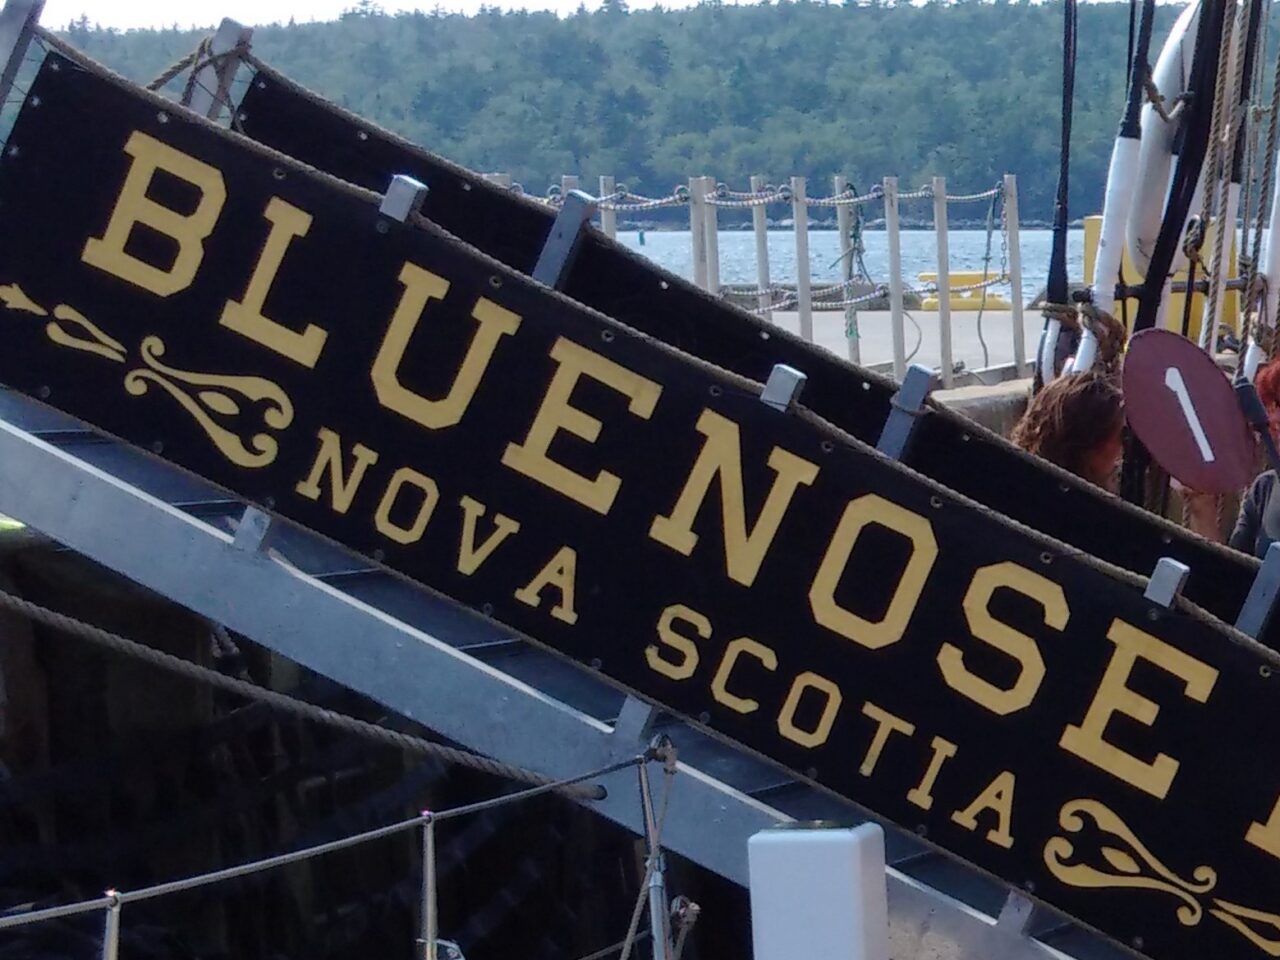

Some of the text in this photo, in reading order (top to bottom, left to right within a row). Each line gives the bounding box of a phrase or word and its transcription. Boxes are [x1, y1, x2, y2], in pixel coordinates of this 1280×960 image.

[81, 130, 1220, 799] BLUENOSE
[1165, 367, 1216, 462] 1
[296, 427, 1014, 849] NOVA SCOTIA
